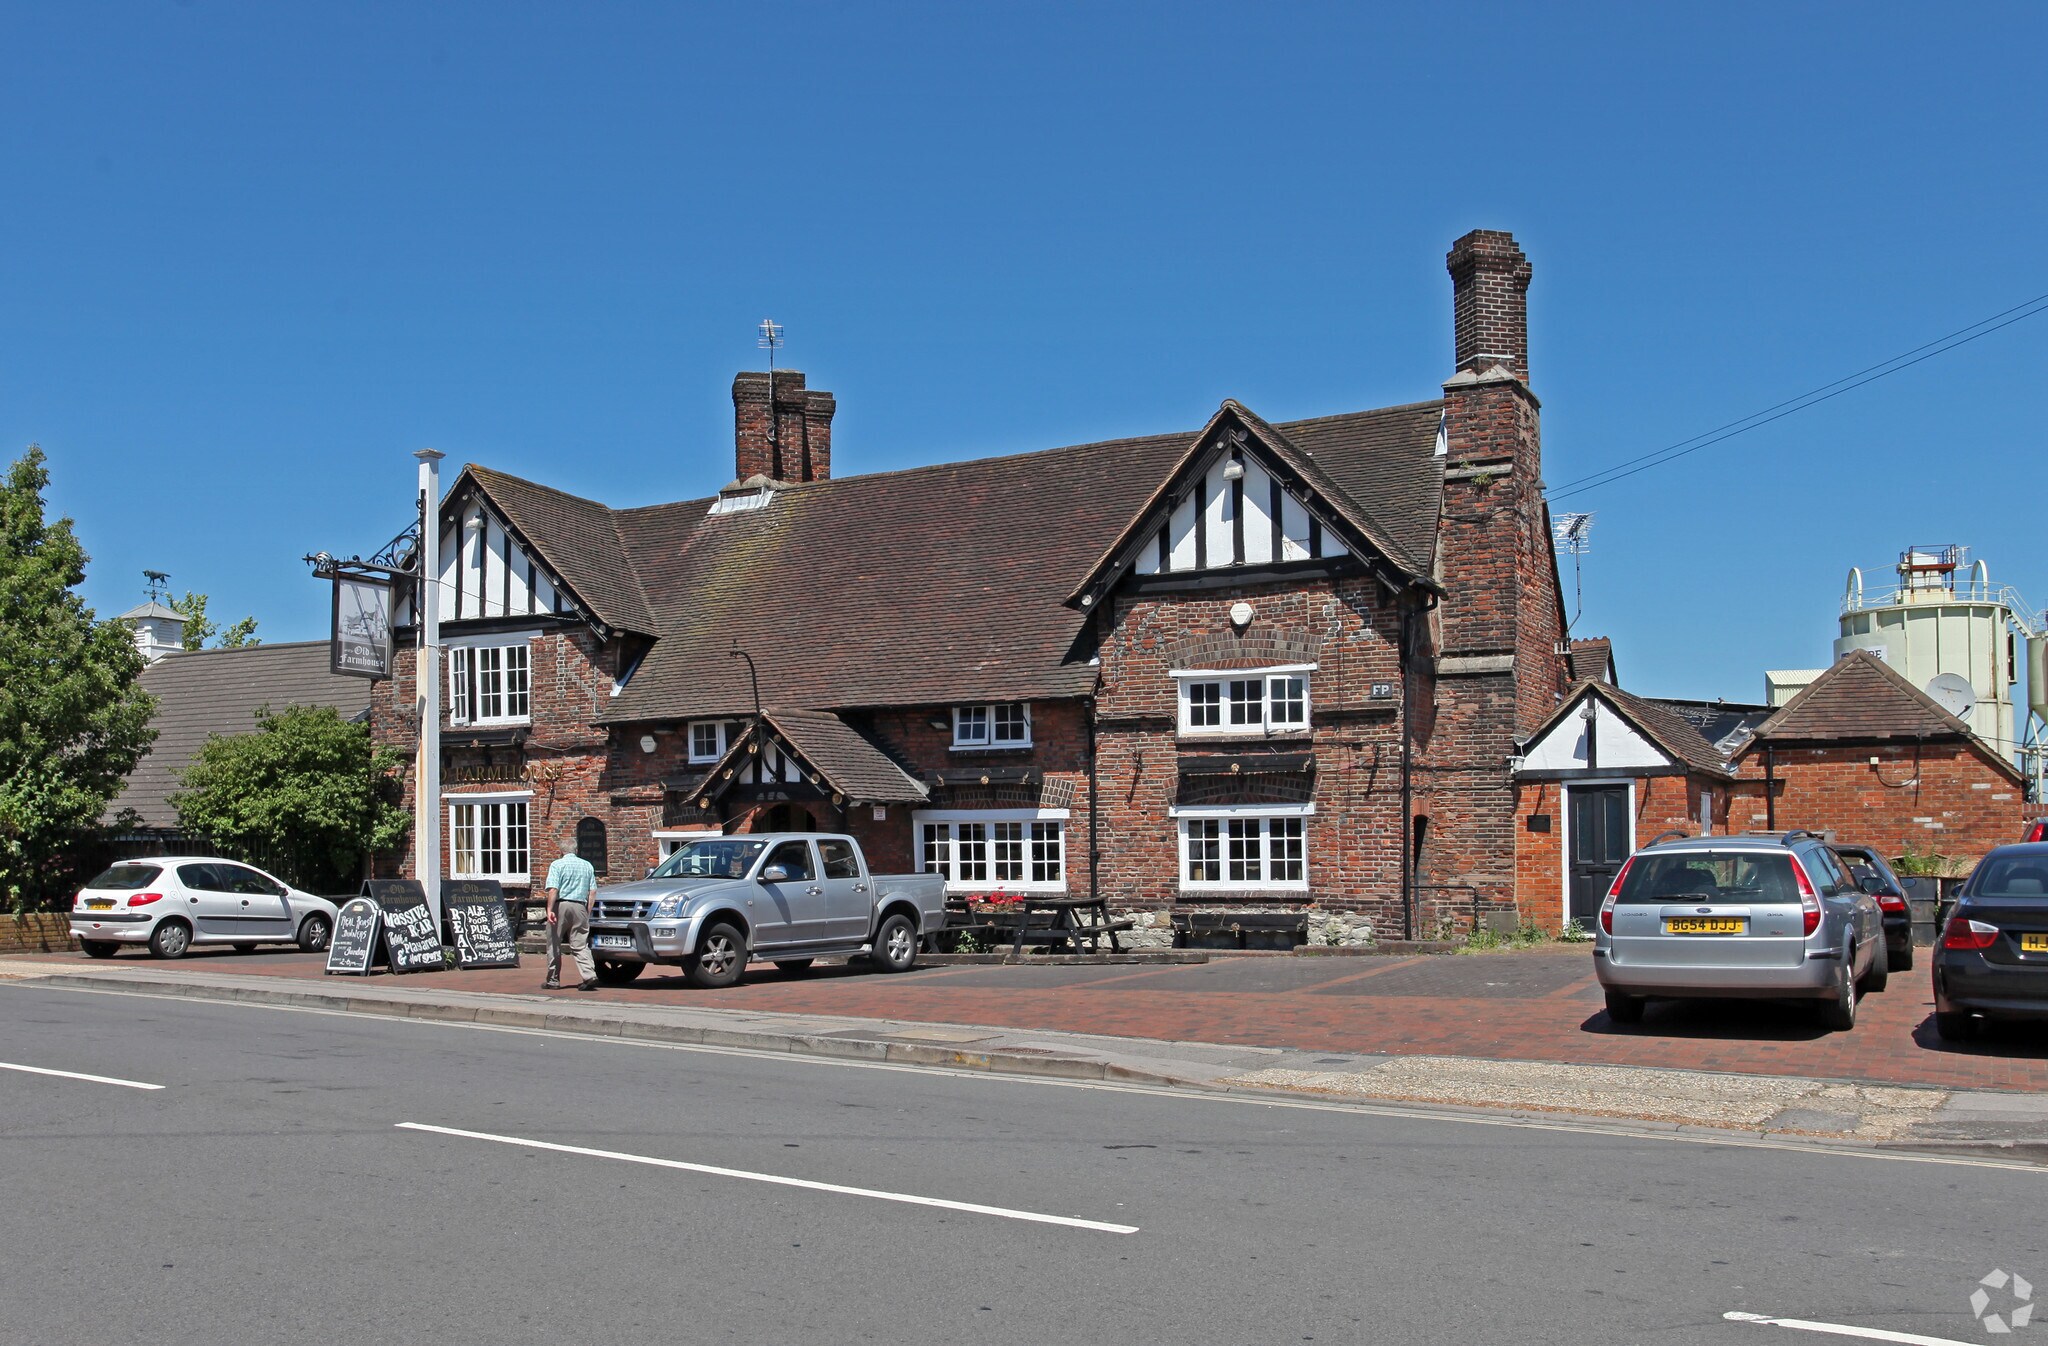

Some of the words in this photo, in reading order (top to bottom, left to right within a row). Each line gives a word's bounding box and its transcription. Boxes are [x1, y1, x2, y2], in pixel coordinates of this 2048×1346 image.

[353, 645, 370, 656] Old
[339, 653, 385, 668] Farmhouse
[1373, 685, 1389, 695] FP
[456, 763, 564, 781] FARMHOUSE
[462, 884, 480, 893] Old
[450, 894, 498, 904] Farmhouse
[470, 925, 491, 934] PUB
[1672, 919, 1706, 931] BG54
[1710, 919, 1736, 931] DJJ
